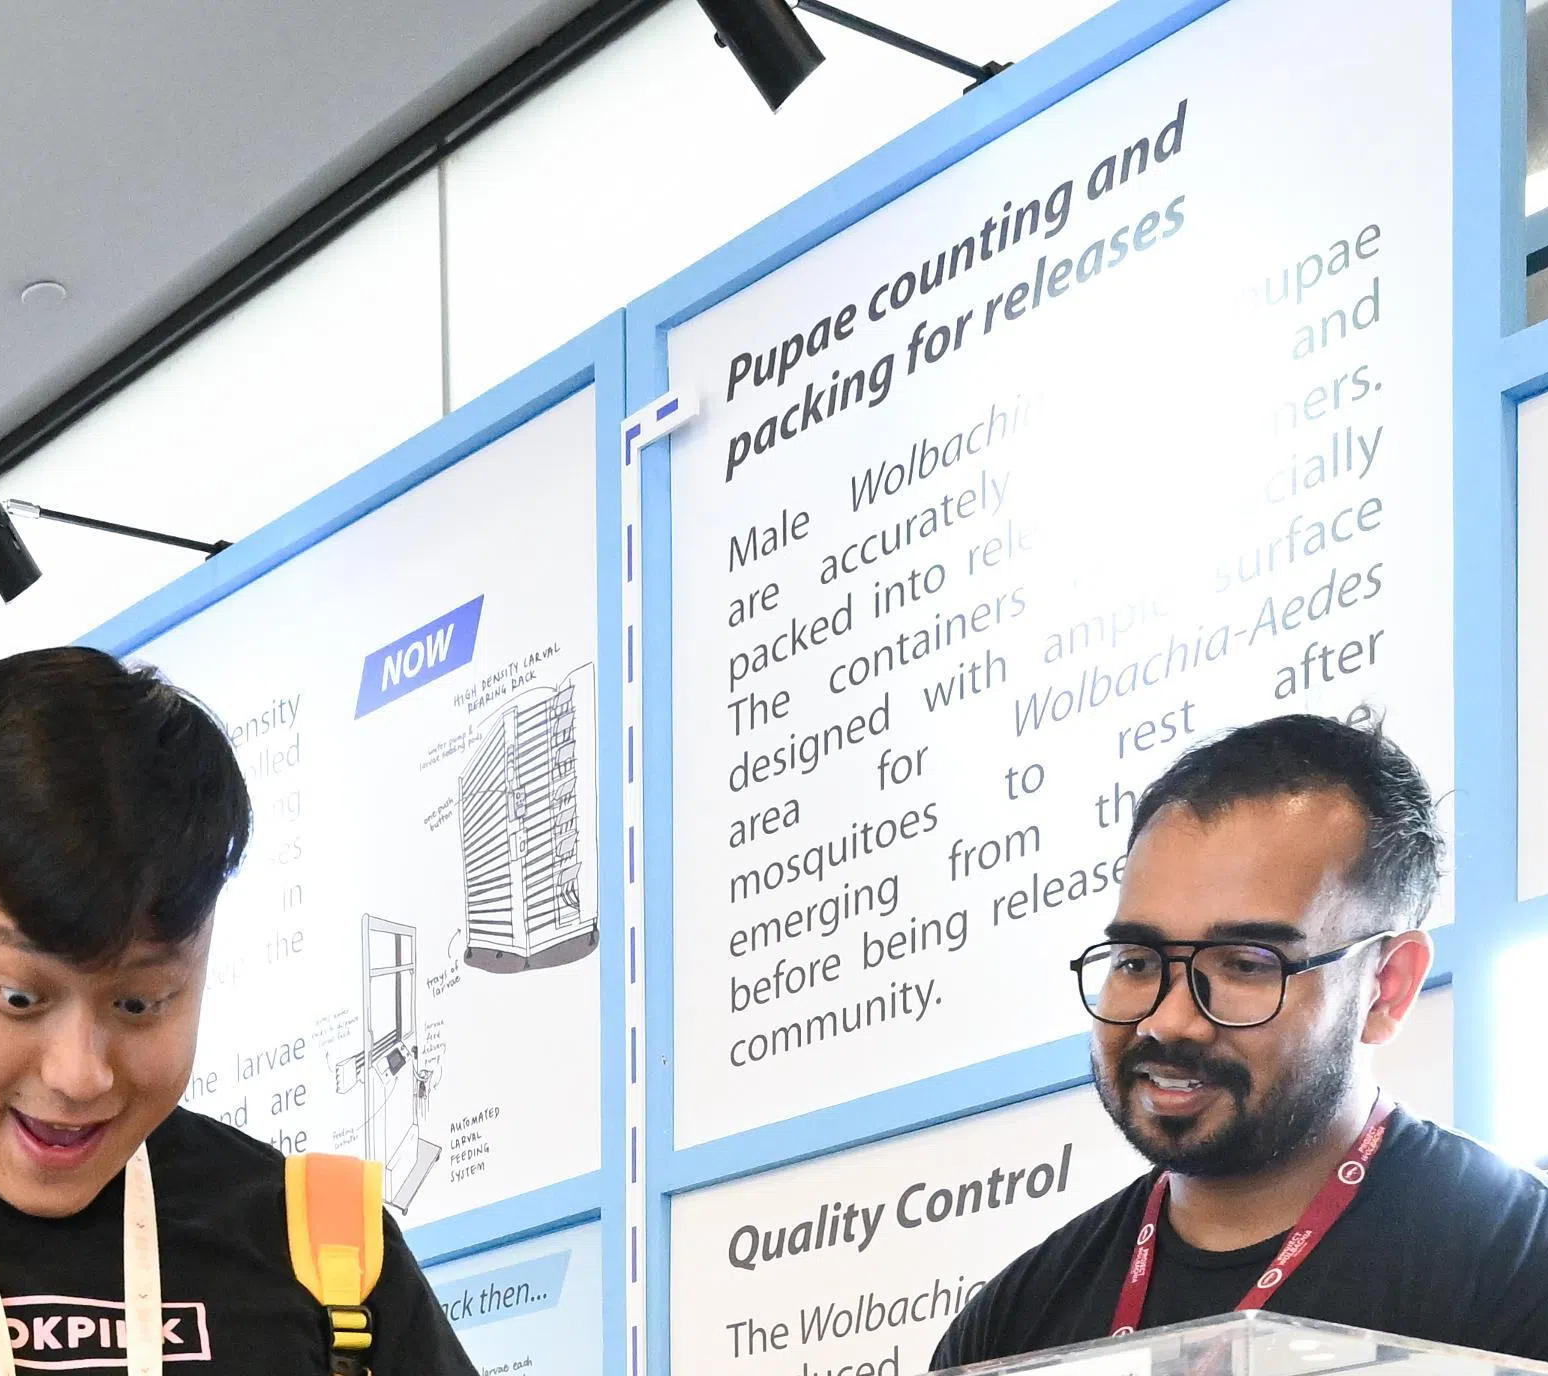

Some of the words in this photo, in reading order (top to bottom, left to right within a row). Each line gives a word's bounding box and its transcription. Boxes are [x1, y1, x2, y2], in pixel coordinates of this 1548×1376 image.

[728, 306, 857, 401] Pupae
[867, 178, 1073, 319] counting
[1086, 100, 1187, 201] and
[724, 354, 893, 481] packing
[904, 305, 975, 377] for
[982, 192, 1187, 339] releases
[728, 586, 780, 628] are
[820, 467, 1012, 583] accurately
[729, 501, 809, 572] Male
[380, 623, 455, 692] NOW
[728, 600, 853, 692] packed
[872, 560, 945, 623] into
[728, 689, 790, 739] The
[827, 583, 1028, 695] containers
[454, 686, 477, 707] HIGH
[482, 663, 518, 691] DENSITY
[523, 643, 560, 671] LARVAL
[512, 670, 537, 692] RACK
[728, 795, 801, 849] area
[877, 743, 927, 789] for
[1013, 558, 1384, 736] Wolbachia-Aedes
[728, 695, 892, 795] designed
[923, 651, 1007, 712] with
[728, 802, 938, 904] mosquitoes
[1005, 764, 1044, 799] to
[1117, 698, 1196, 761] rest
[1273, 623, 1385, 703] after
[728, 872, 900, 958] emerging
[947, 818, 1042, 879] from
[728, 951, 841, 1012] before
[862, 914, 968, 973] being
[728, 975, 941, 1068] community.
[450, 1107, 499, 1133] AUTOMATED
[450, 1142, 489, 1166] FEEDING
[451, 1132, 481, 1149] LARVAL
[450, 1162, 484, 1183] SYSTEM
[729, 1202, 885, 1271] Quality
[897, 1143, 1072, 1228] Control
[480, 1282, 547, 1314] then...
[727, 1320, 789, 1358] The
